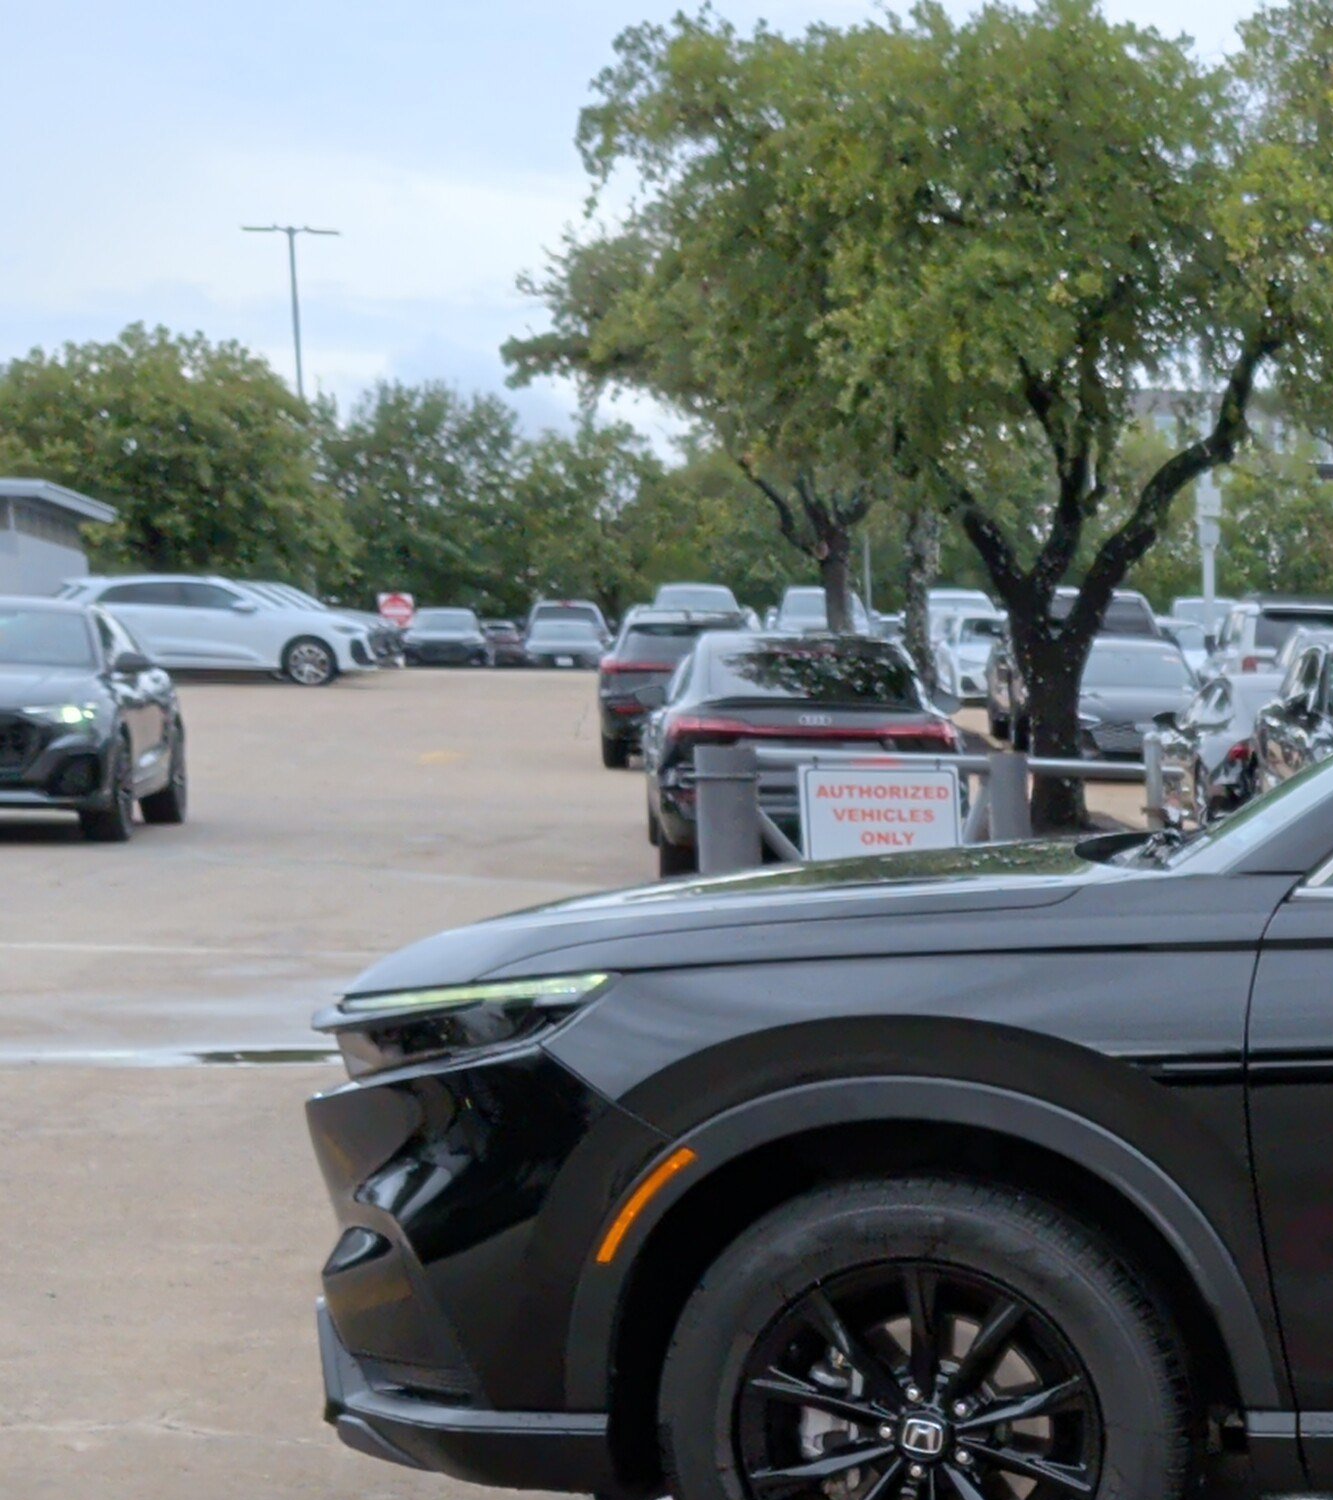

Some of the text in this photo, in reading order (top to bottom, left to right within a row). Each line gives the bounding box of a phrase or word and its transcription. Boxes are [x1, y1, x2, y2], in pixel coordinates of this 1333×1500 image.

[816, 785, 949, 800] AUTHORIZED
[833, 808, 935, 823] VEHICLES
[861, 831, 914, 845] ONLY
